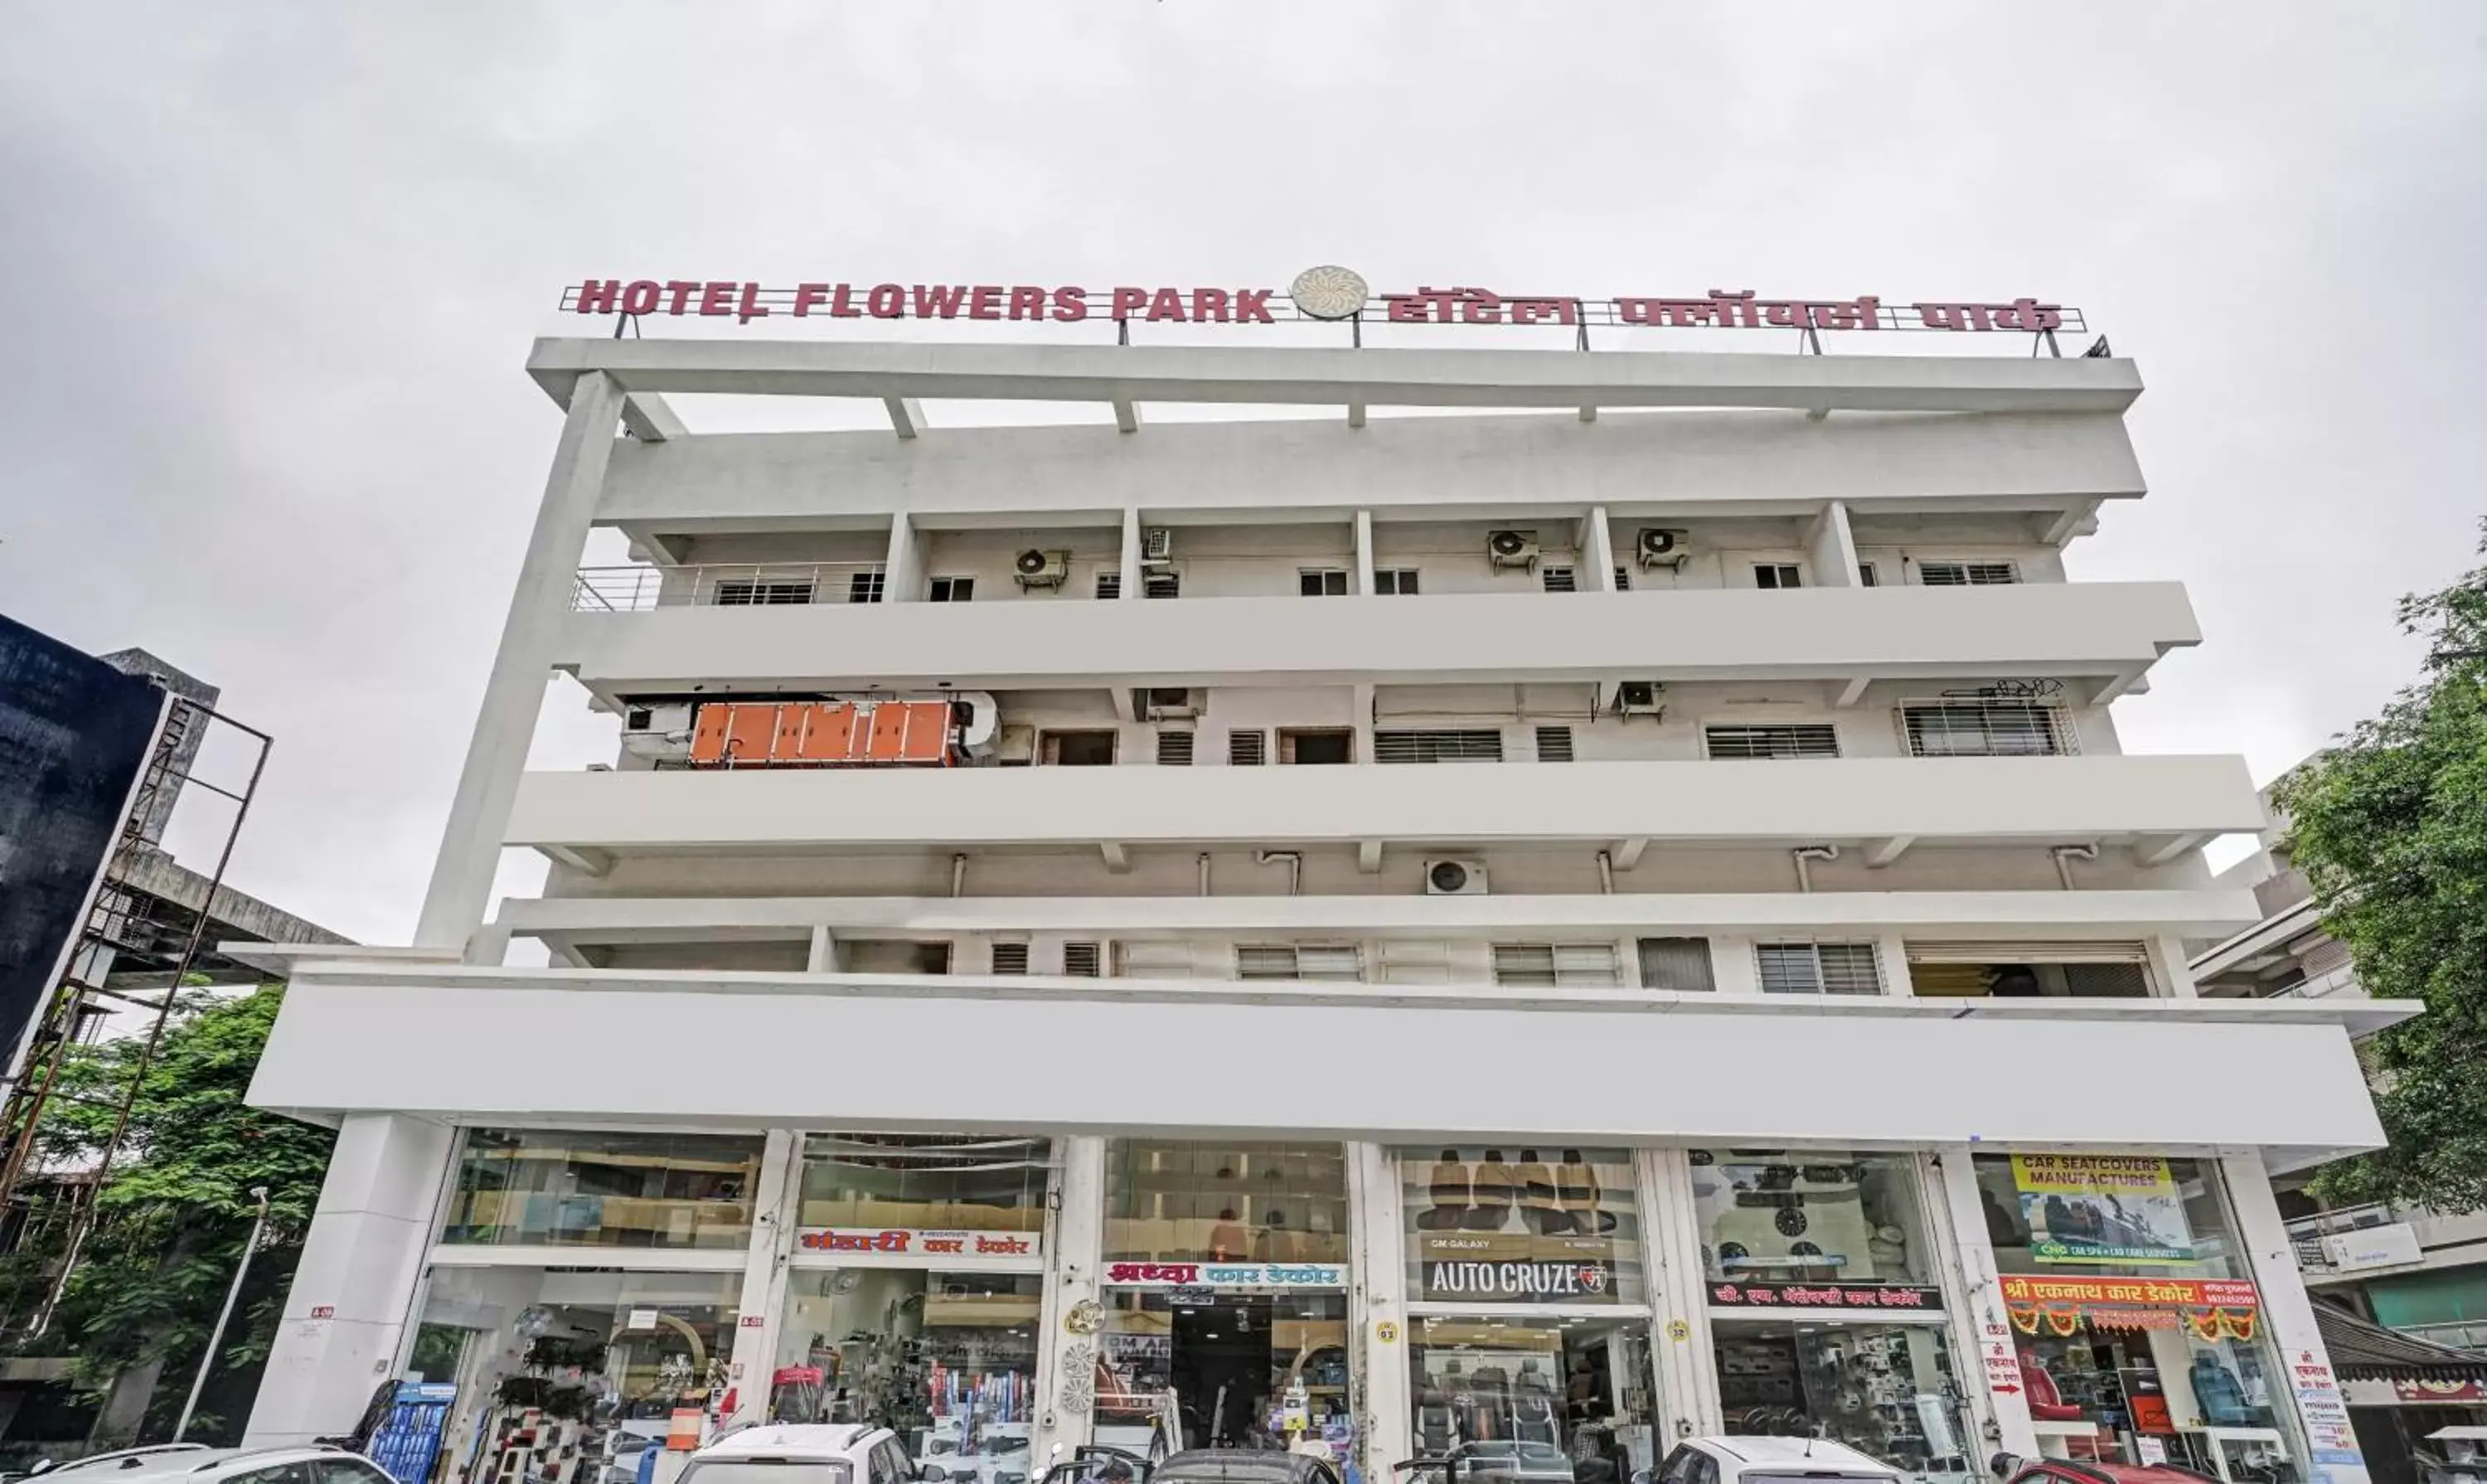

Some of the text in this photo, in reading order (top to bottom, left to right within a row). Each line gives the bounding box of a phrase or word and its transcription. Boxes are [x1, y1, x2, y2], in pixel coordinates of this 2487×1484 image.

[578, 279, 1275, 323] HOTEL FLOWERS PARK
[1381, 286, 1581, 324] हॉटेल
[1913, 298, 2062, 331] पार्क
[2023, 1157, 2161, 1171] CAR SEATCOVERS
[2030, 1171, 2157, 1186] MANUFACTURES
[800, 1229, 1030, 1254] भंडारी कार डेकोर
[1449, 1239, 1491, 1249] GALAXY
[1205, 1268, 1262, 1284] कार
[1266, 1265, 1341, 1285] डेकोर
[1432, 1262, 1495, 1293] AUTO
[1499, 1263, 1579, 1293] CRUZE
[1845, 1290, 1878, 1306] कार
[2005, 1279, 2029, 1299] श्री
[2032, 1283, 2102, 1301] एकनाथ
[2106, 1284, 2144, 1301] कार
[2145, 1282, 2196, 1302] डेकोर
